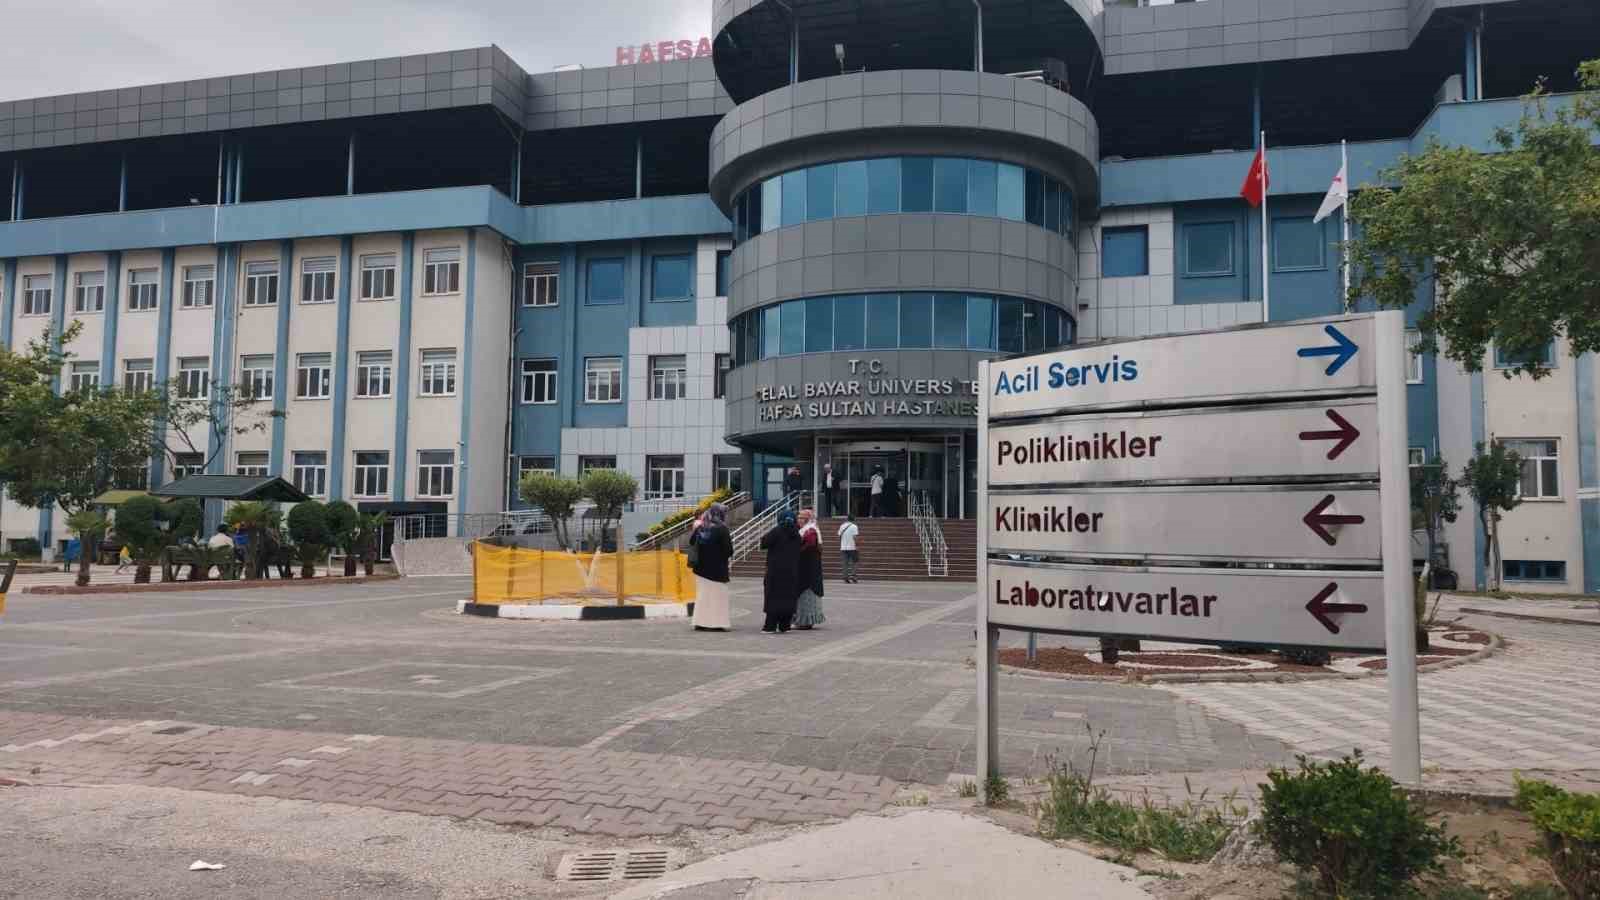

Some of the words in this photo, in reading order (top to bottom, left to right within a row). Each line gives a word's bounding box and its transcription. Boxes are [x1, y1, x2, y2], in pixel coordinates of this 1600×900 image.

[615, 36, 713, 65] HAFSA
[995, 366, 1039, 395] Acil
[1047, 355, 1138, 389] Servis
[756, 384, 798, 402] ELAL
[804, 381, 861, 398] BAYAR
[760, 403, 803, 421] HAFSA
[808, 400, 876, 418] SULTAN
[997, 431, 1162, 466] Poliklinikler
[995, 506, 1104, 533] Klinikler
[996, 580, 1218, 618] Laboratuvarlar
